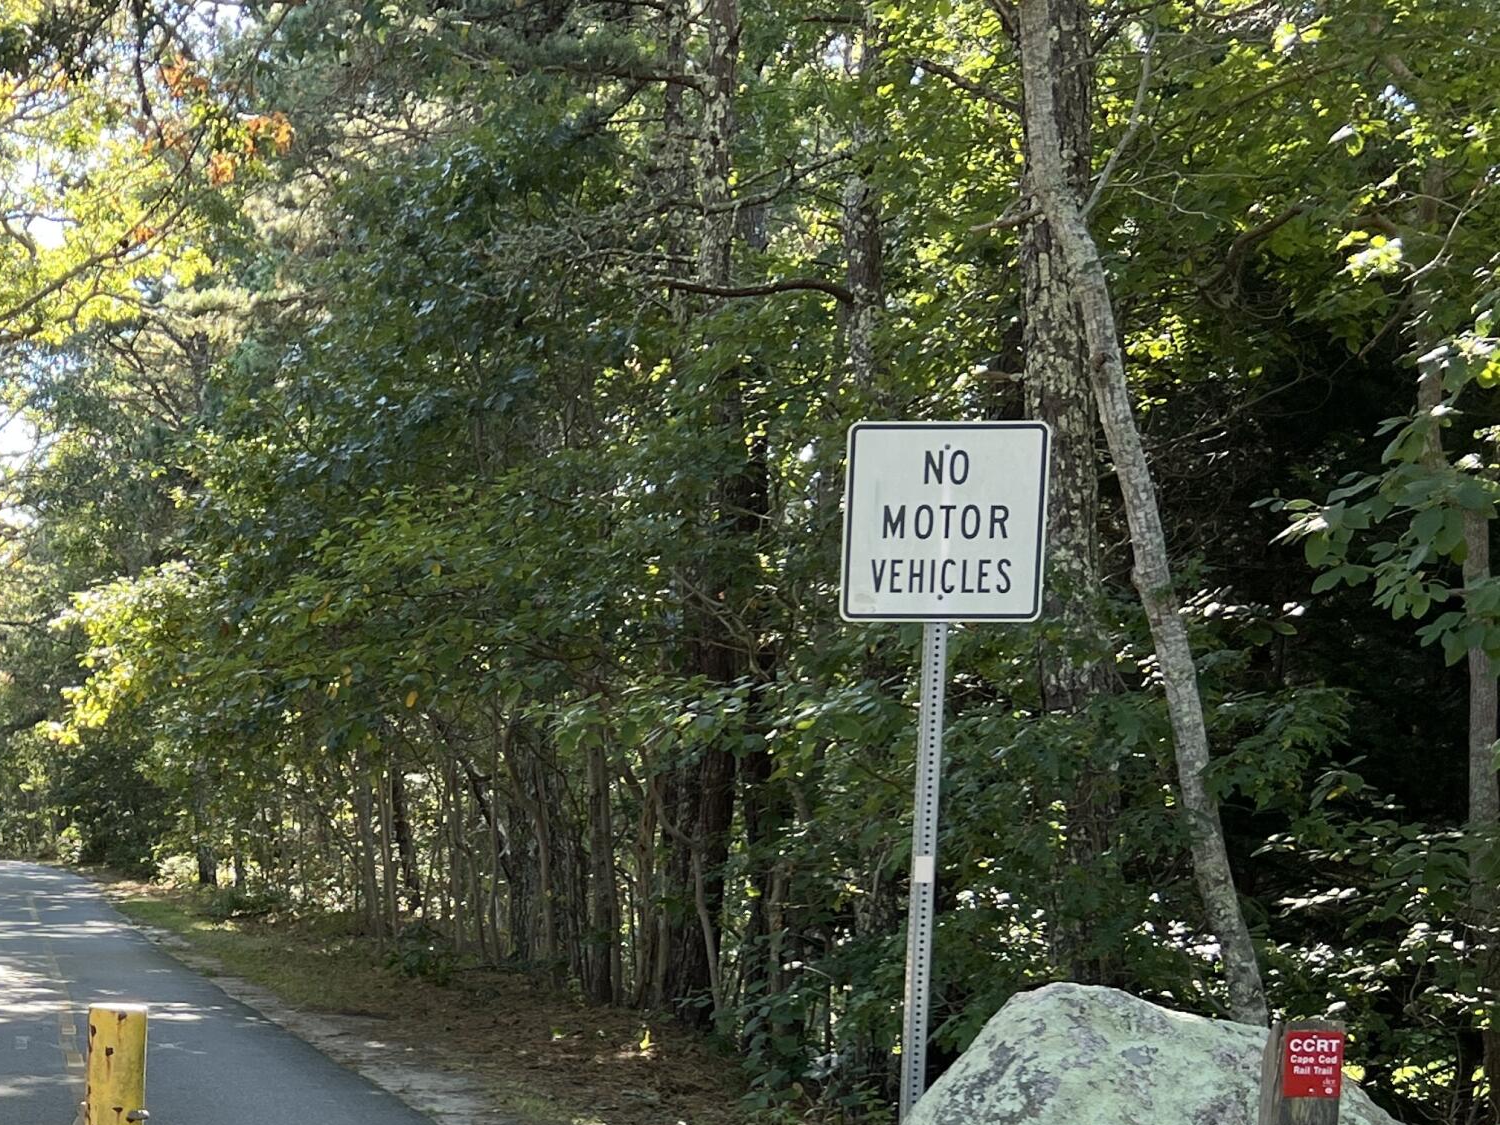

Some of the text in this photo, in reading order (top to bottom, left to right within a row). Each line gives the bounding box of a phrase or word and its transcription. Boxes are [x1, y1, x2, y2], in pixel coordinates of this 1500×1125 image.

[924, 450, 969, 485] NO
[882, 504, 1009, 539] MOTOR
[871, 558, 1011, 593] VEHICLES
[1289, 1038, 1340, 1052] CCRT
[1290, 1055, 1337, 1064] Cape Cod
[1293, 1066, 1333, 1075] Rail Trail
